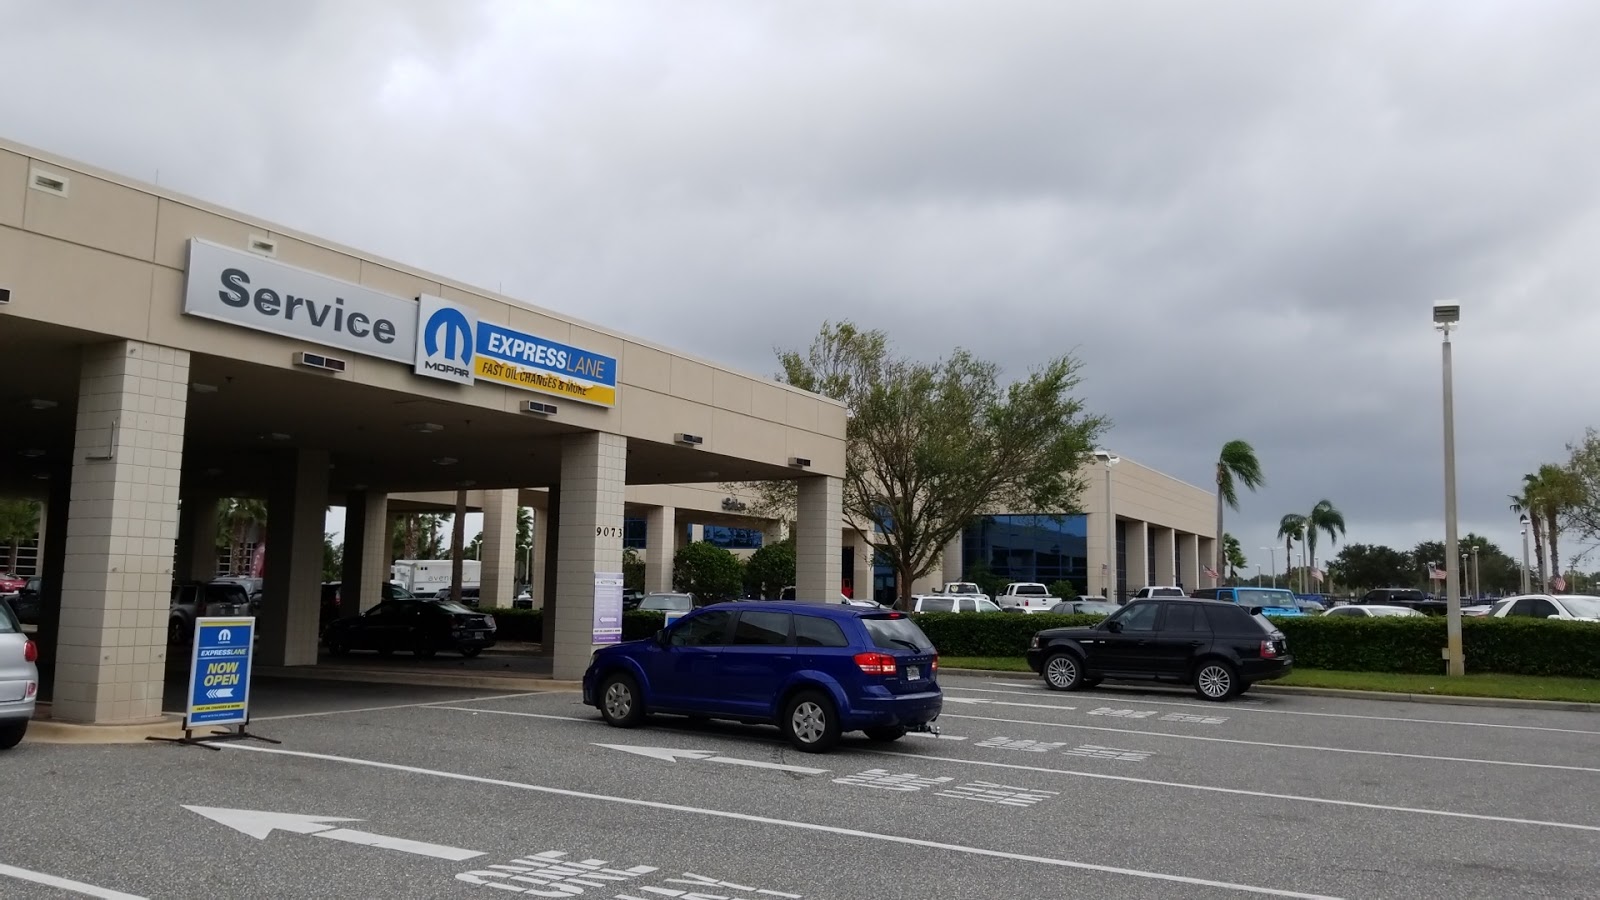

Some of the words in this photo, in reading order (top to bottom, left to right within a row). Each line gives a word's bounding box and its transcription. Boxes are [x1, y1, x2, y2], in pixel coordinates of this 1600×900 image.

[218, 267, 396, 344] Service
[424, 360, 470, 379] MOPAR
[482, 361, 504, 377] FAST
[505, 367, 518, 381] OIL
[519, 370, 558, 390] CHANGES
[565, 382, 587, 396] MORE
[596, 526, 623, 538] 9073
[207, 662, 239, 674] NOW
[203, 674, 239, 686] OPEN
[454, 850, 660, 898] ONE
